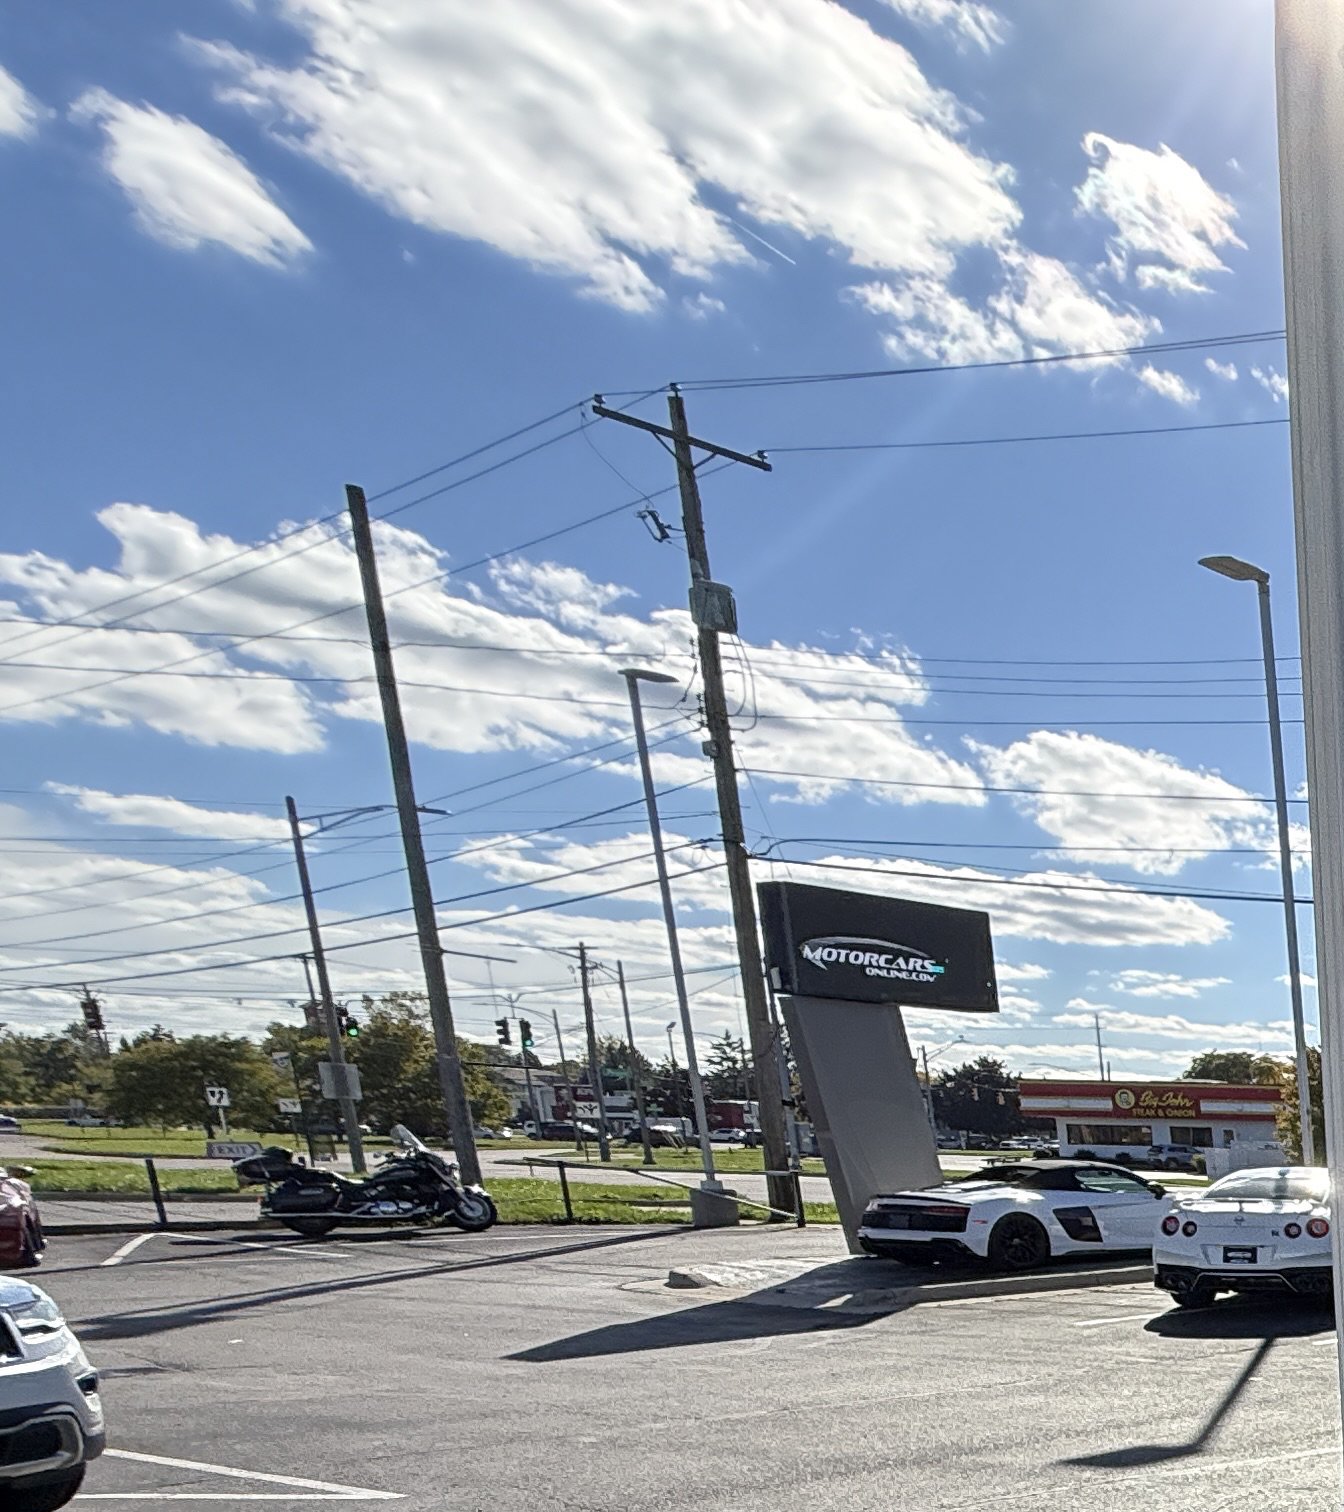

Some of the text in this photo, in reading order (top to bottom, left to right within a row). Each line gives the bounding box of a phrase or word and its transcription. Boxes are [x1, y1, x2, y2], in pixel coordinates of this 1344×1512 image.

[802, 945, 937, 972] MOTORCARS
[1132, 1108, 1156, 1117] STEAK
[1165, 1108, 1196, 1118] ONION
[216, 1145, 247, 1154] EXIT
